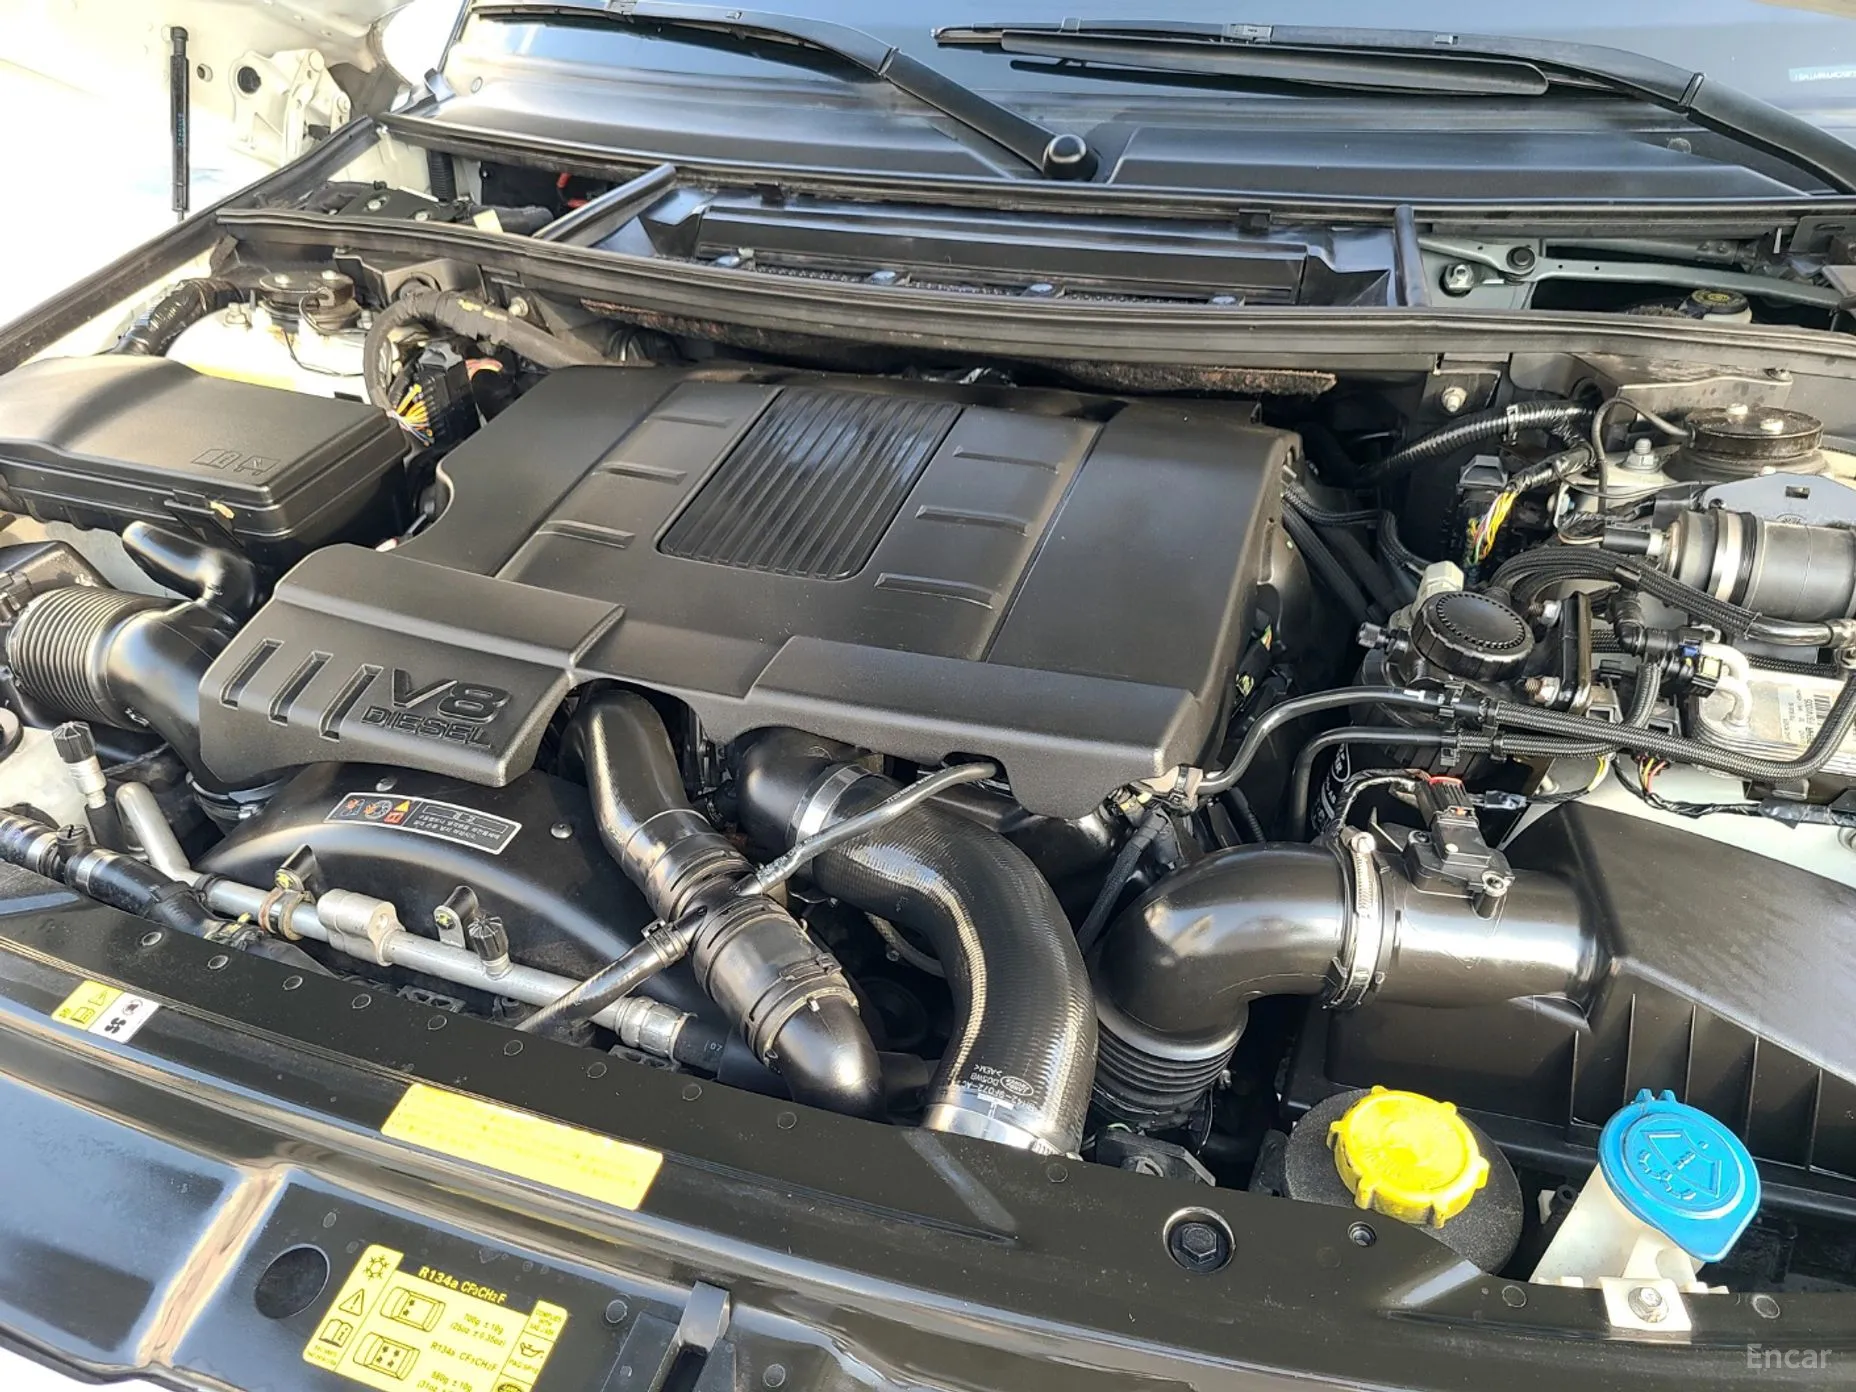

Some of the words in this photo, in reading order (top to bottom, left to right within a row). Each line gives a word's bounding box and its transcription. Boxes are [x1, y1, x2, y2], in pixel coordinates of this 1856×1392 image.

[392, 668, 512, 725] V8
[361, 705, 492, 748] DIESEL
[418, 1266, 459, 1289] R134a
